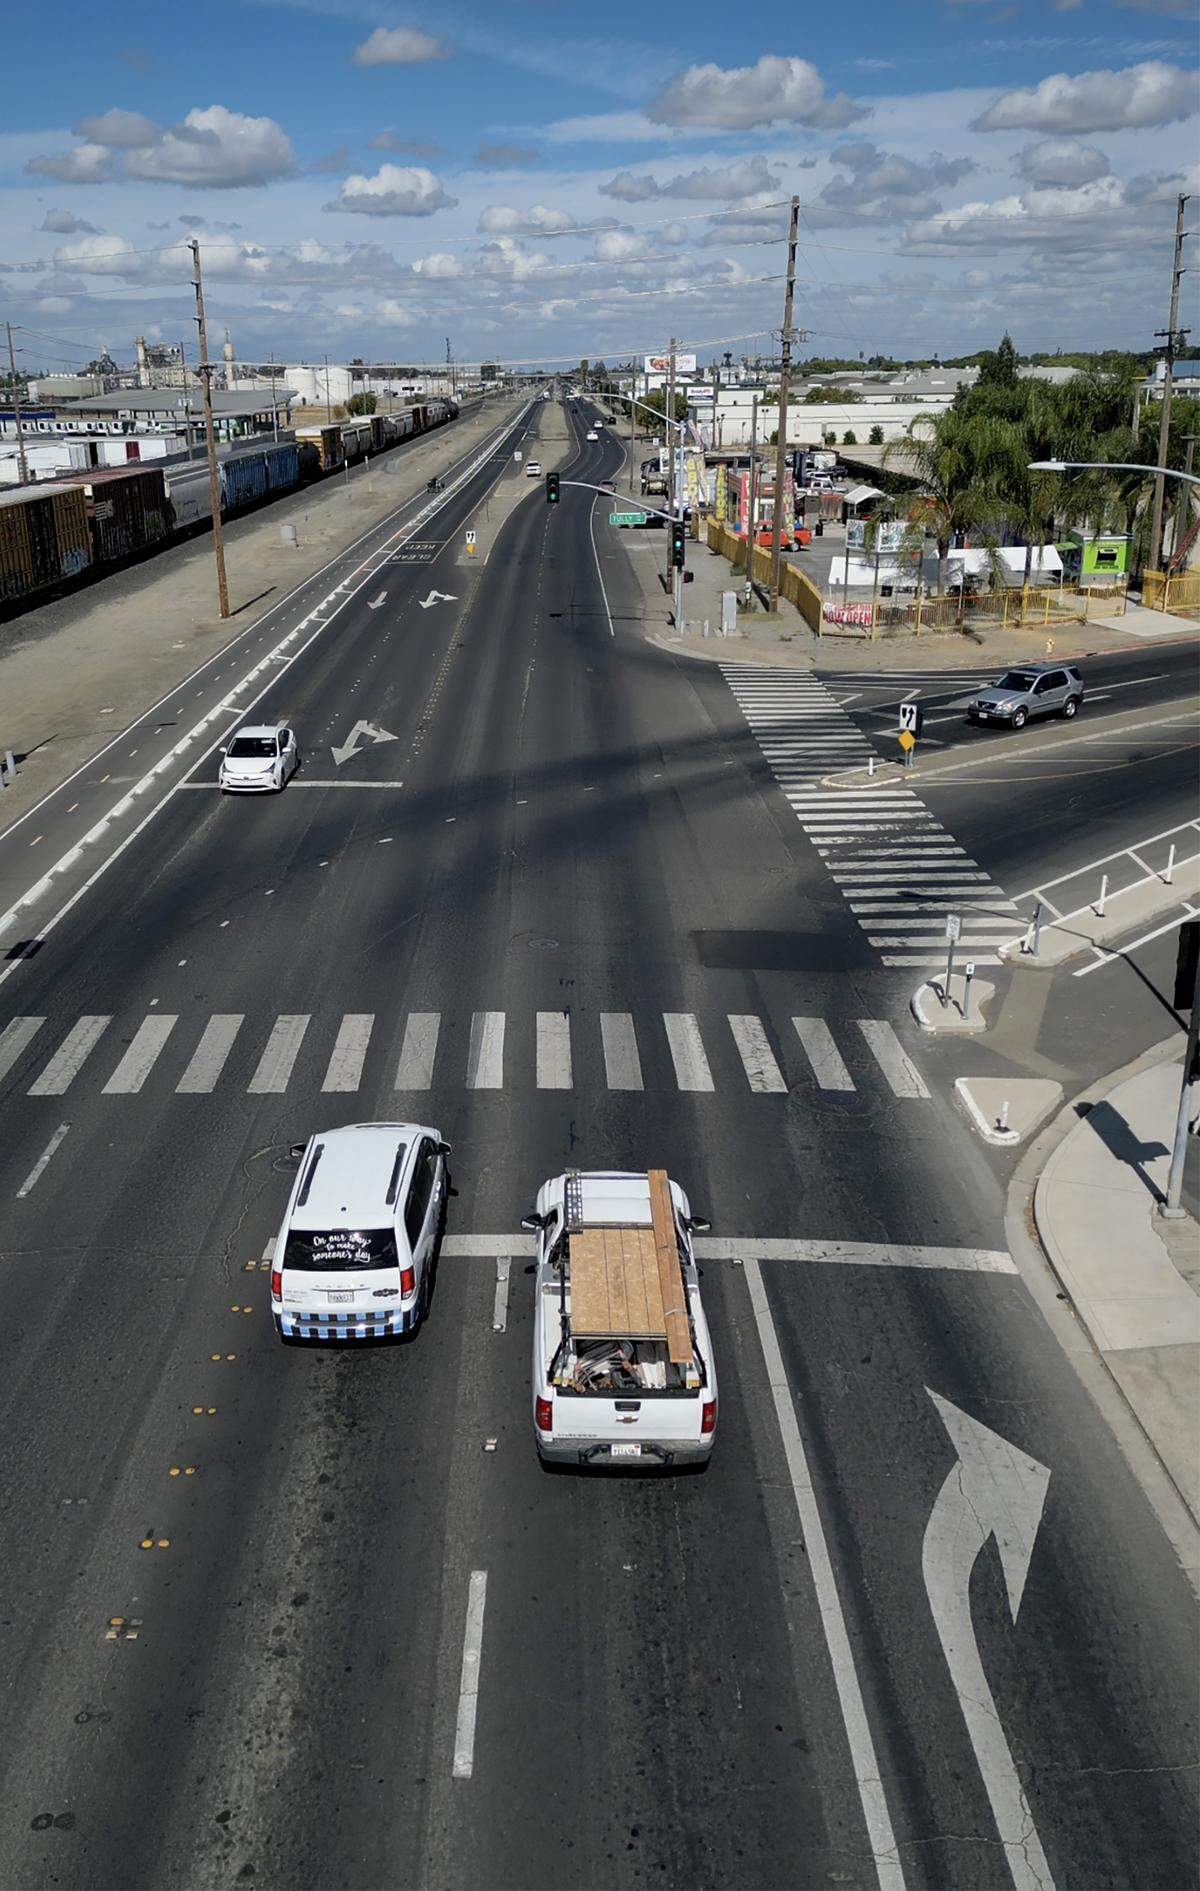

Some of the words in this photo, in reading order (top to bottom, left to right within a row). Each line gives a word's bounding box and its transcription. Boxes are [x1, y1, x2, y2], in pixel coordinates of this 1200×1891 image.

[847, 610, 873, 627] OPEN
[313, 1235, 327, 1246] On
[328, 1233, 347, 1242] our
[312, 1250, 353, 1261] someone's
[354, 1248, 371, 1263] day
